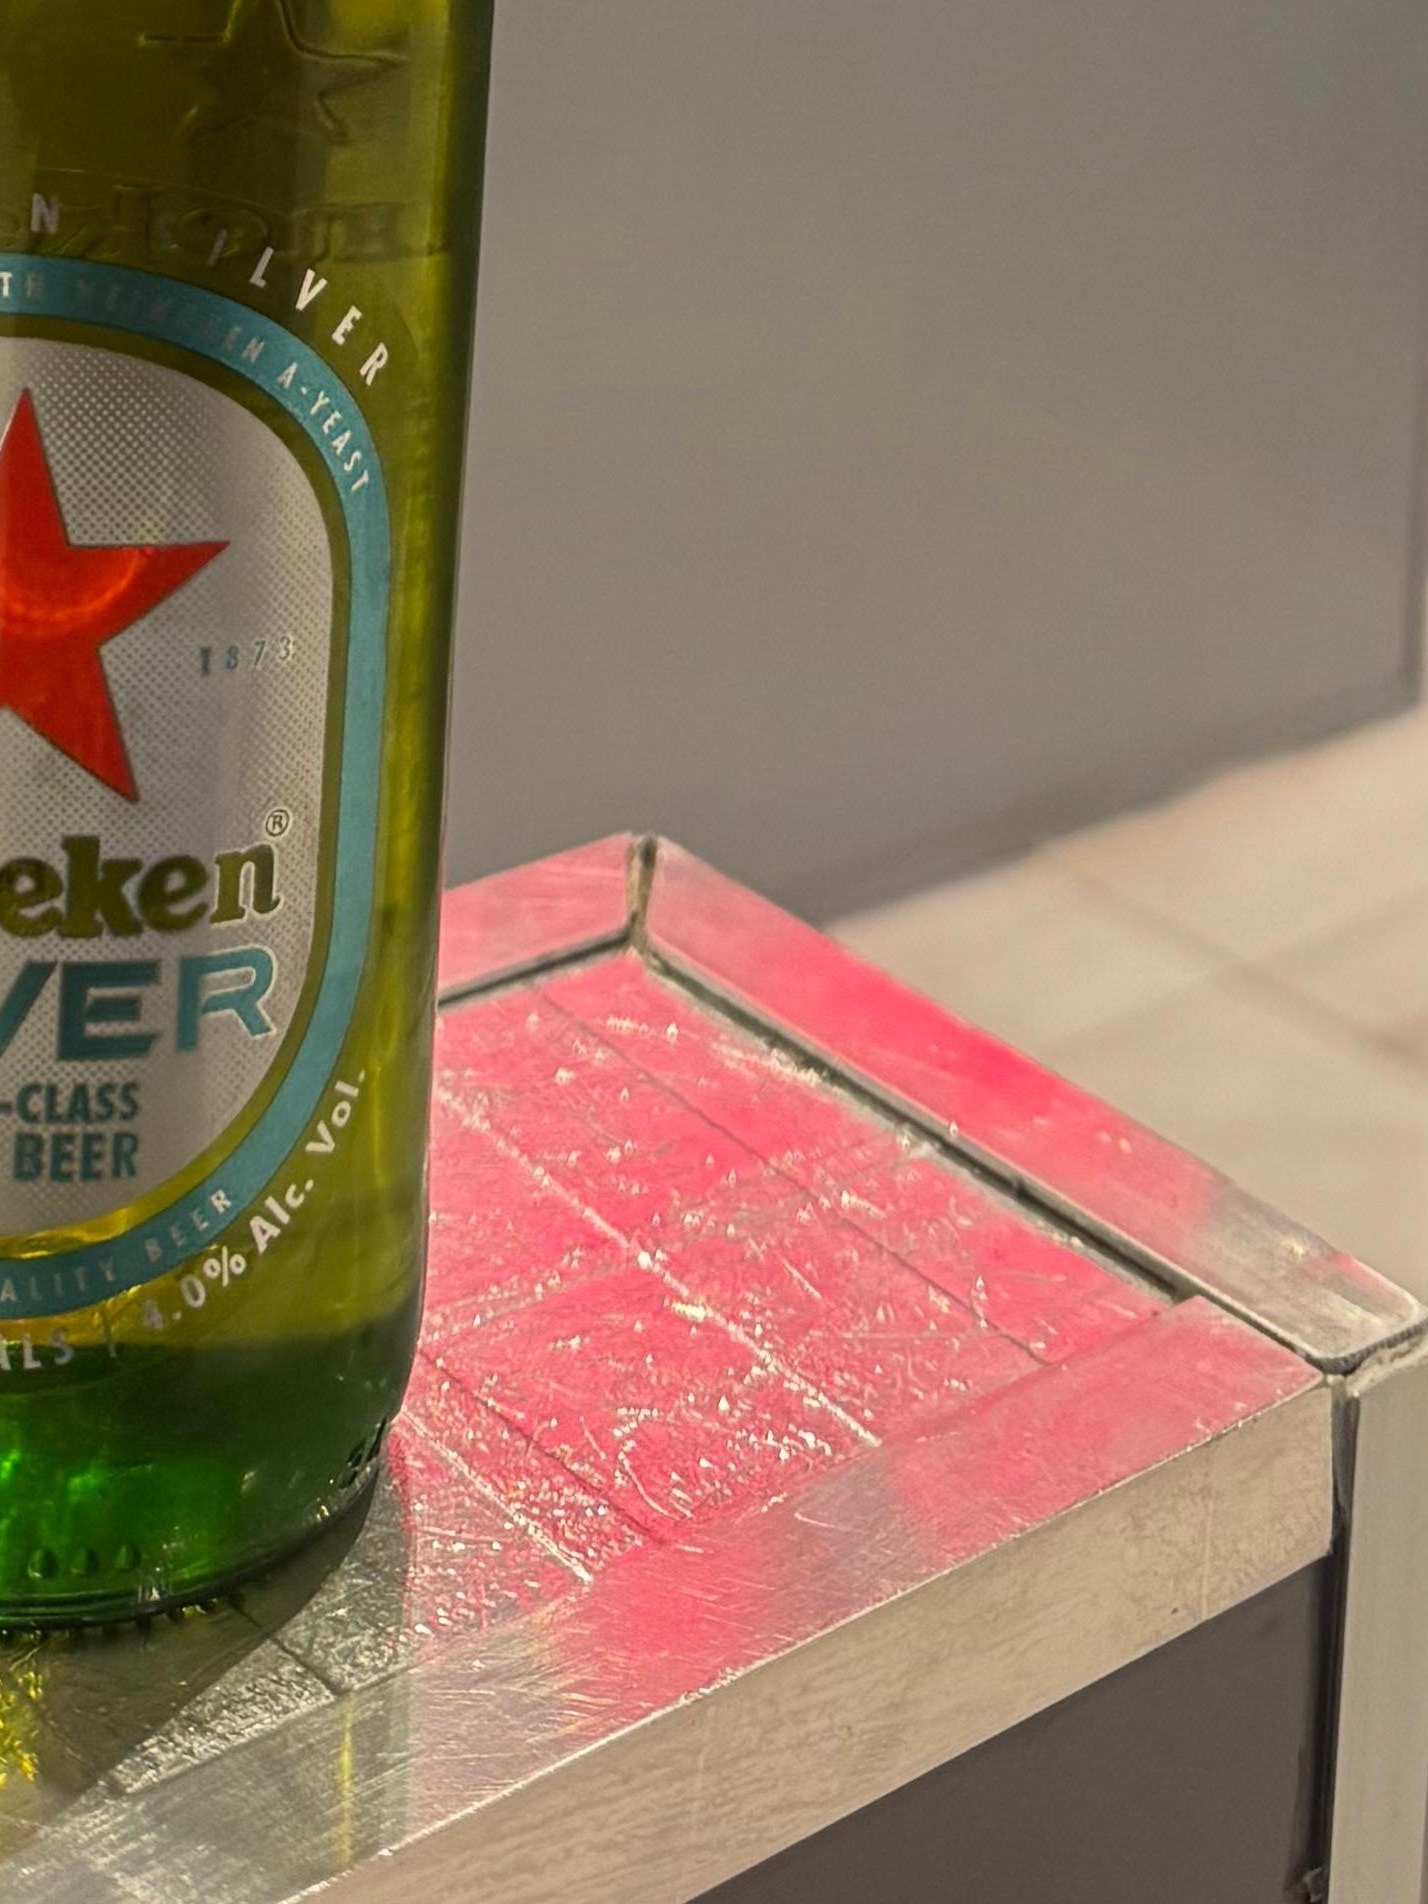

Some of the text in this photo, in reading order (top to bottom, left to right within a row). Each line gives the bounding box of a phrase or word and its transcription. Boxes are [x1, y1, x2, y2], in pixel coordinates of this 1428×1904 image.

[277, 361, 369, 491] A-YEAST
[199, 635, 291, 677] 1873
[13, 1131, 140, 1183] BEER
[249, 1179, 315, 1255] Alc.
[305, 1069, 366, 1155] Vol.
[145, 1189, 233, 1264] BEER
